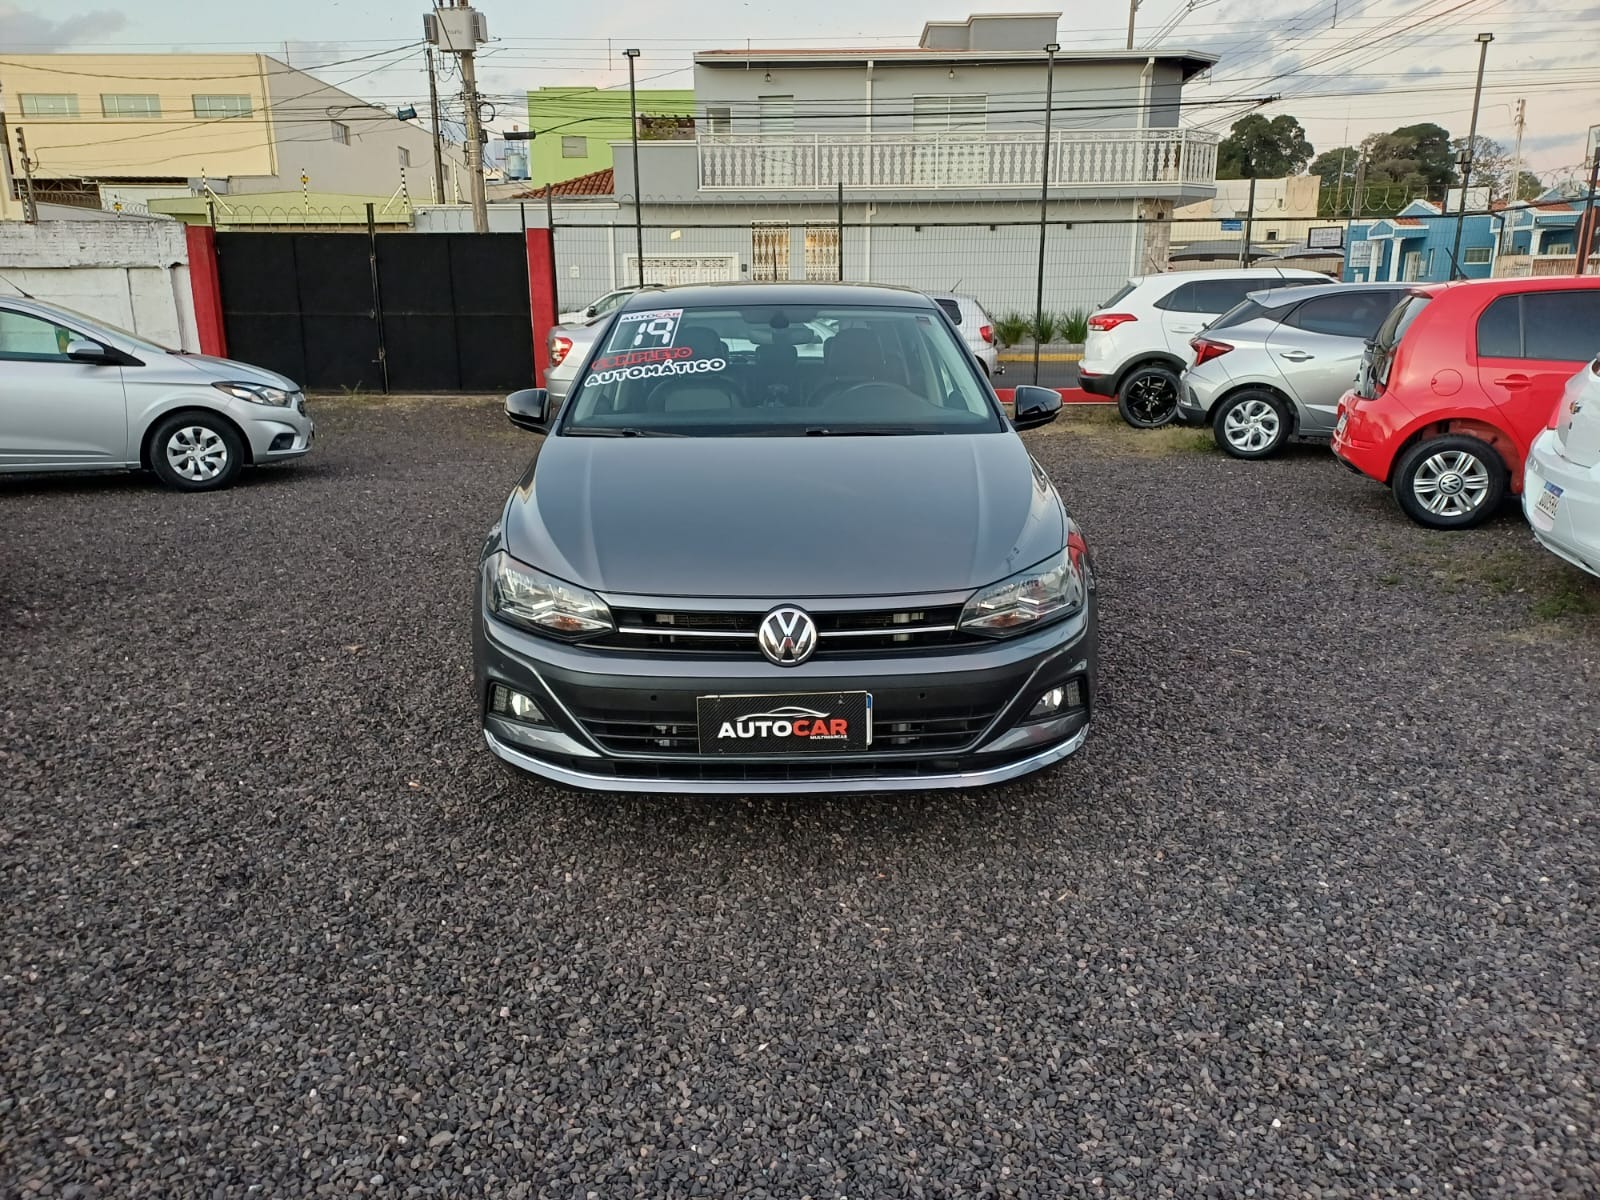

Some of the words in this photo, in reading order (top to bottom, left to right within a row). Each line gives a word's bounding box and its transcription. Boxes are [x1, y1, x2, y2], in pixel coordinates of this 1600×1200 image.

[622, 312, 680, 321] AUTOCAR
[633, 319, 675, 346] 19
[591, 347, 693, 371] COMPLETO
[584, 358, 726, 387] AUTOMÁTICO
[759, 607, 816, 662] VW
[717, 719, 848, 739] AUTOCAR
